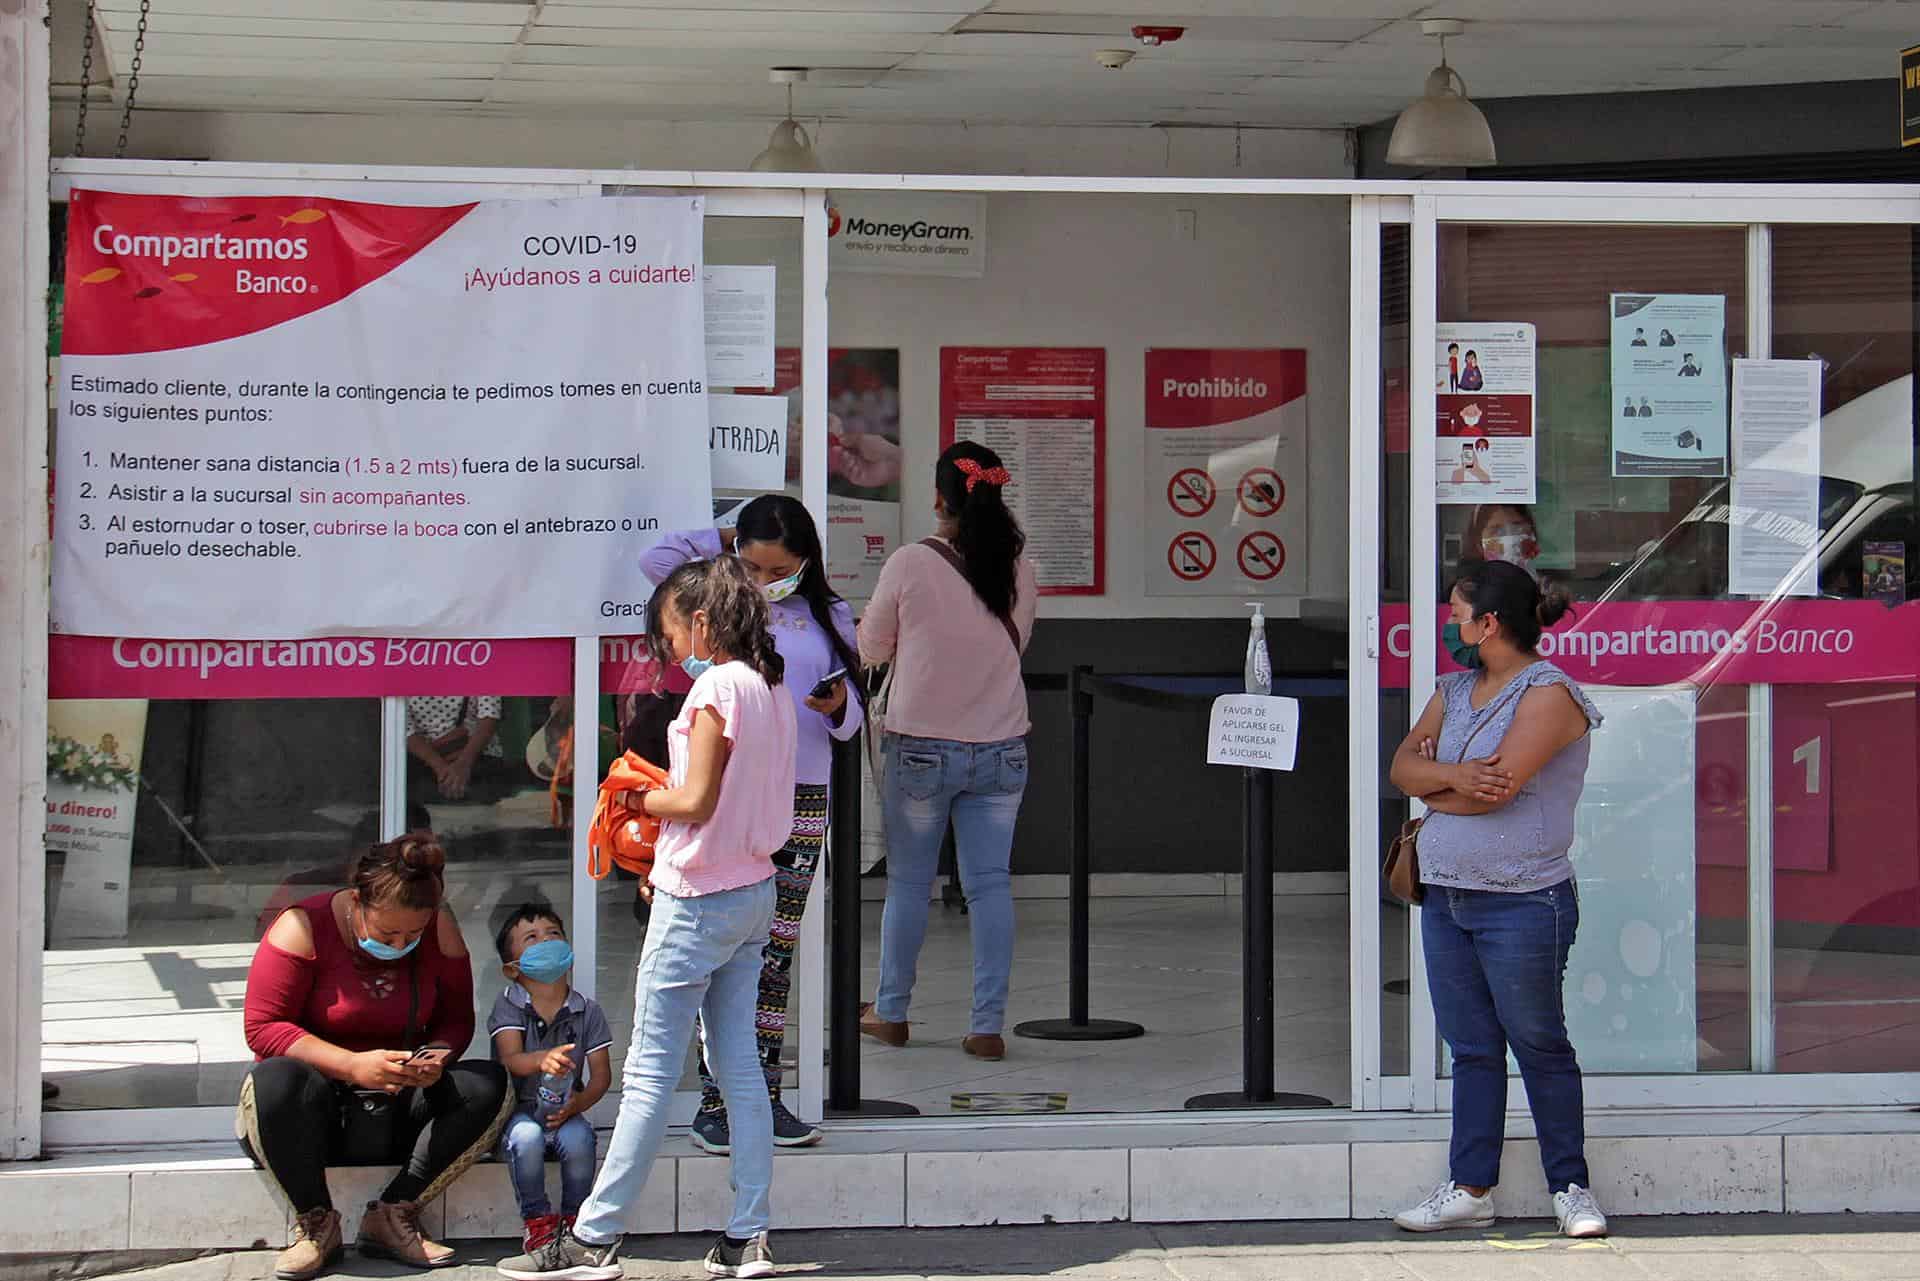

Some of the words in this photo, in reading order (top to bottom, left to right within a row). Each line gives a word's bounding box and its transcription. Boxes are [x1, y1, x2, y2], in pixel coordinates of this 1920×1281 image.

[93, 225, 308, 266] Compartamos
[523, 234, 637, 256] COVID-19
[919, 243, 932, 253] de
[934, 244, 969, 255] dinero
[235, 269, 307, 294] Banco
[464, 267, 581, 292] ¡Ayúdanos
[588, 270, 601, 284] a
[609, 263, 696, 285] cuidarte!
[70, 374, 159, 395] Estimado
[164, 379, 232, 399] cliente,
[238, 380, 309, 397] durante
[315, 381, 331, 398] la
[336, 383, 446, 404] contingencia
[453, 385, 469, 400] te
[475, 382, 553, 403] pedimos
[560, 383, 615, 397] tomes
[621, 382, 642, 396] en
[647, 380, 702, 396] cuenta
[1163, 377, 1267, 398] Prohibido
[70, 400, 97, 417] los
[103, 402, 199, 423] siguientes
[205, 406, 273, 424] puntos:
[709, 426, 779, 457] TRADA
[82, 451, 98, 468] 1.
[110, 452, 201, 471] Mantener
[205, 457, 250, 472] sana
[257, 455, 340, 473] distancia
[345, 457, 380, 477] (1.5
[385, 460, 396, 474] a
[400, 458, 411, 475] 2
[418, 458, 458, 478] mts)
[463, 458, 510, 474] fuera
[515, 456, 538, 472] de
[545, 456, 560, 471] la
[566, 453, 645, 471] sucursal.
[80, 482, 97, 499] 2.
[108, 483, 168, 502] Asistir
[173, 488, 184, 502] a
[191, 485, 207, 502] la
[213, 487, 292, 503] sucursal
[299, 488, 326, 504] sin
[332, 489, 471, 509] acompañantes.
[79, 513, 96, 531] 3.
[107, 515, 126, 532] Al
[132, 516, 235, 534] estornudar
[240, 521, 252, 534] o
[259, 518, 309, 538] toser,
[313, 520, 388, 536] cubrirse
[394, 519, 408, 536] la
[414, 519, 459, 536] boca
[464, 522, 497, 536] con
[503, 519, 519, 534] el
[525, 517, 616, 533] antebrazo
[621, 518, 632, 532] o
[637, 516, 658, 530] un
[105, 539, 181, 558] pañuelo
[187, 540, 301, 558] desechable.
[600, 600, 648, 616] Graci
[1535, 623, 1747, 665] ompartamos
[1756, 621, 1854, 656] Banco
[112, 637, 376, 680] Compartamos
[383, 637, 492, 666] Banco
[1223, 705, 1253, 716] FAVOR
[1255, 707, 1267, 717] DE
[1222, 719, 1267, 732] APLICARSE
[1269, 723, 1286, 733] GEL
[1221, 735, 1232, 743] AL
[1234, 735, 1277, 746] INGRESAR
[1220, 747, 1227, 755] A
[1228, 748, 1273, 760] SUCURSAL
[1793, 736, 1820, 793] 1
[61, 800, 118, 820] dinero!
